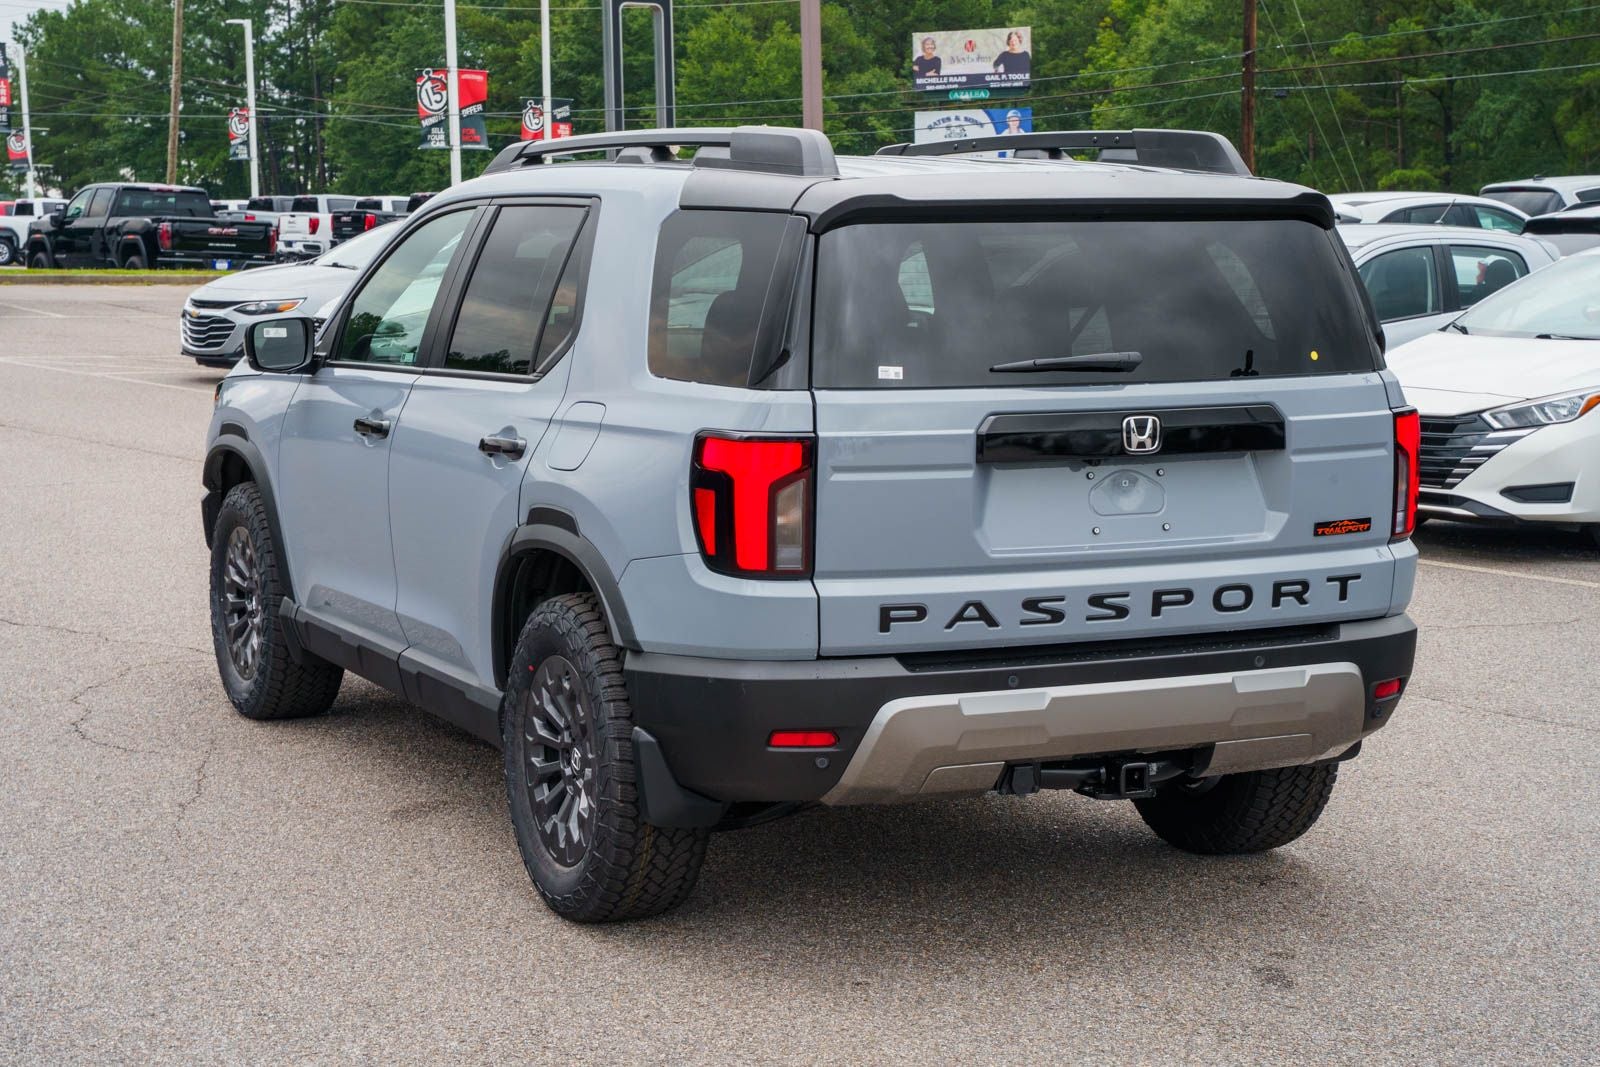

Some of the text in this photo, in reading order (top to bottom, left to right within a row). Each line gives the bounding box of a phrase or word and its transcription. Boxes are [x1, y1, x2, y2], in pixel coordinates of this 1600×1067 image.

[424, 82, 443, 107] 15
[461, 103, 483, 118] OFFER
[208, 227, 238, 235] GMC
[878, 573, 1362, 634] PASSPORT
